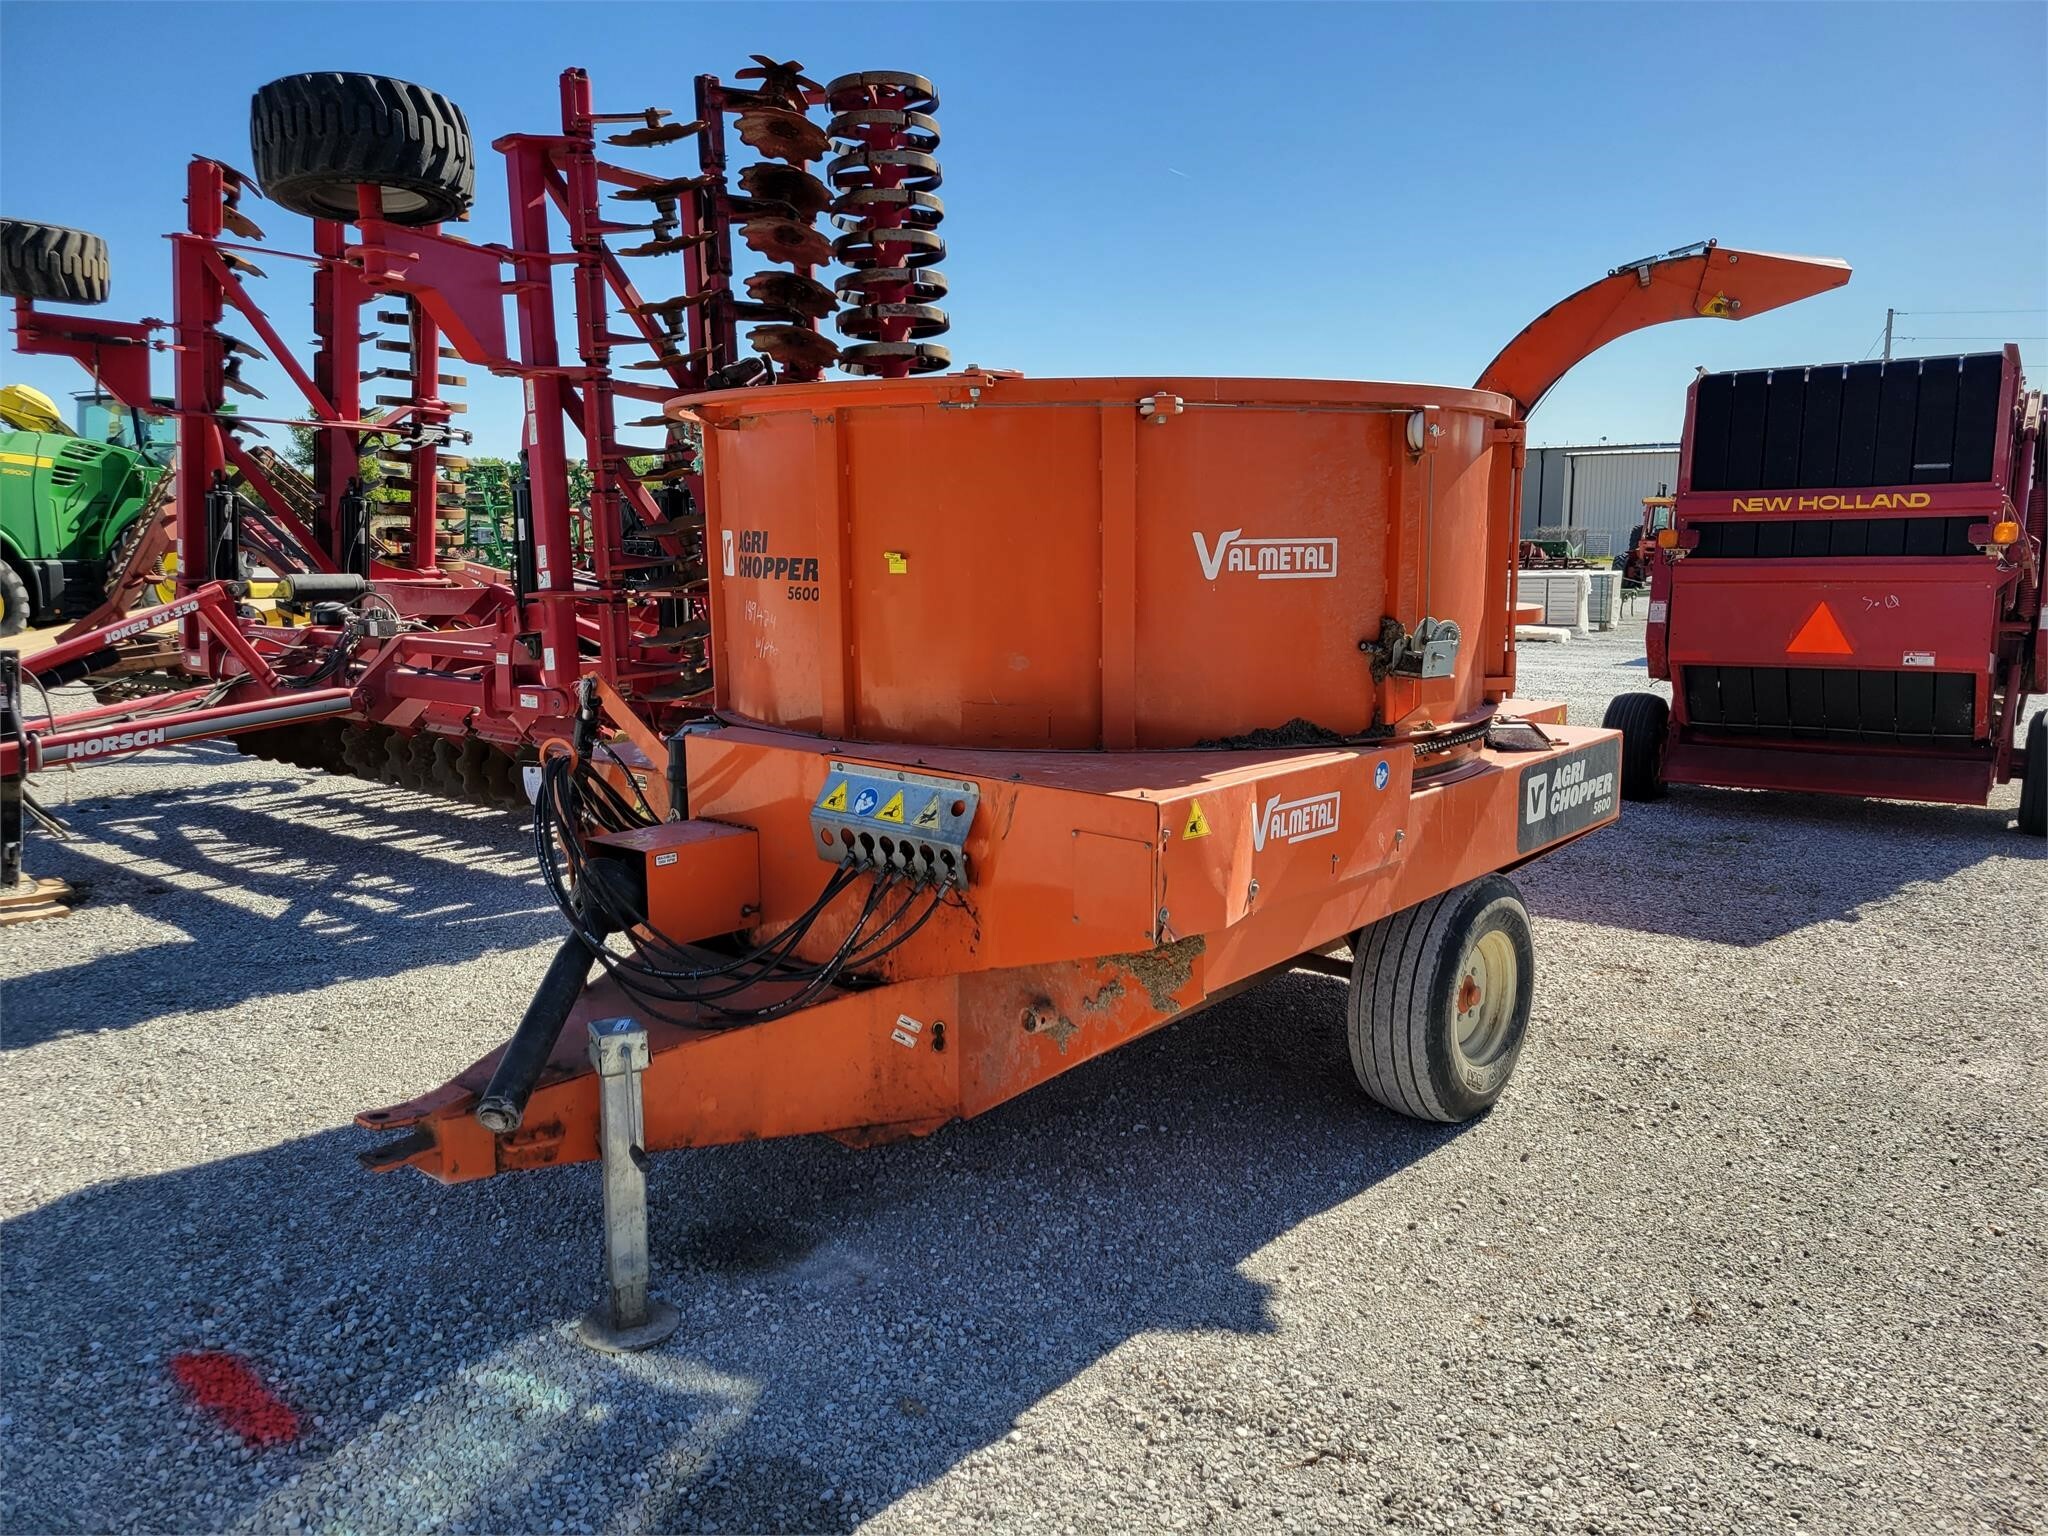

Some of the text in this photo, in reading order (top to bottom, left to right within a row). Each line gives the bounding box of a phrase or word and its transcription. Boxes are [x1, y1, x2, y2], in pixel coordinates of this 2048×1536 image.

[1733, 493, 1931, 512] NEW HOLLAND
[738, 530, 768, 553] AGRI
[739, 555, 818, 582] CHOPPER
[787, 586, 819, 601] 5600
[104, 619, 150, 645] JOKER
[67, 727, 165, 758] HORSCH
[1552, 759, 1586, 791] AGRI
[1550, 772, 1613, 815] CHOPPER
[1593, 796, 1612, 815] 5600
